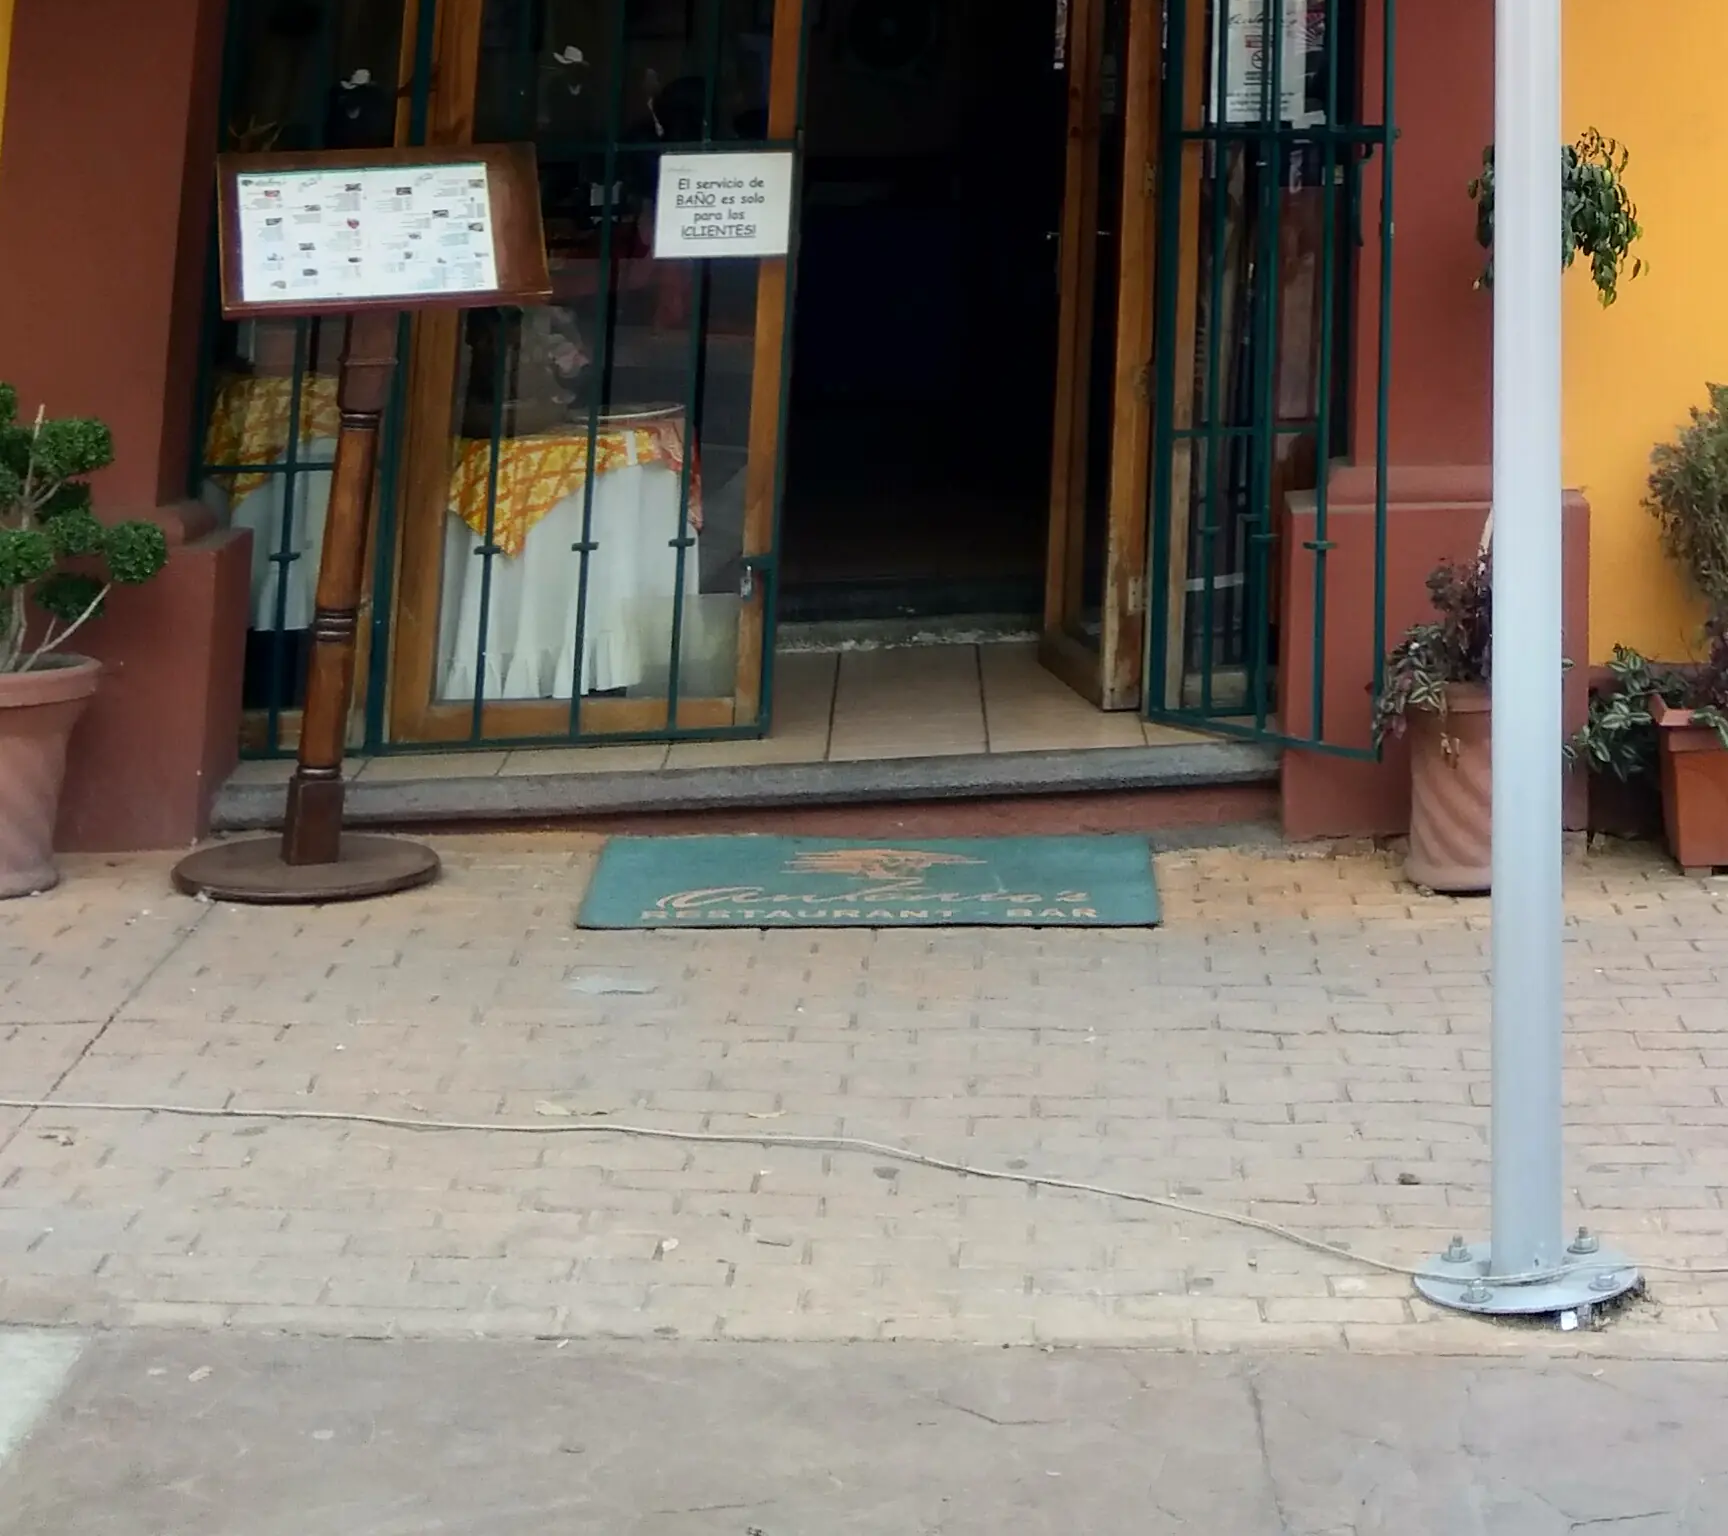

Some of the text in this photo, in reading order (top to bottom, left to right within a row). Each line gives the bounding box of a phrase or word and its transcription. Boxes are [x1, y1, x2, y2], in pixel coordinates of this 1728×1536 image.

[677, 176, 765, 190] El servicio de
[675, 191, 765, 207] BAÑO es solo
[693, 208, 745, 224] para los
[640, 908, 955, 920] RESTAURANT
[1005, 909, 1099, 920] BAR
